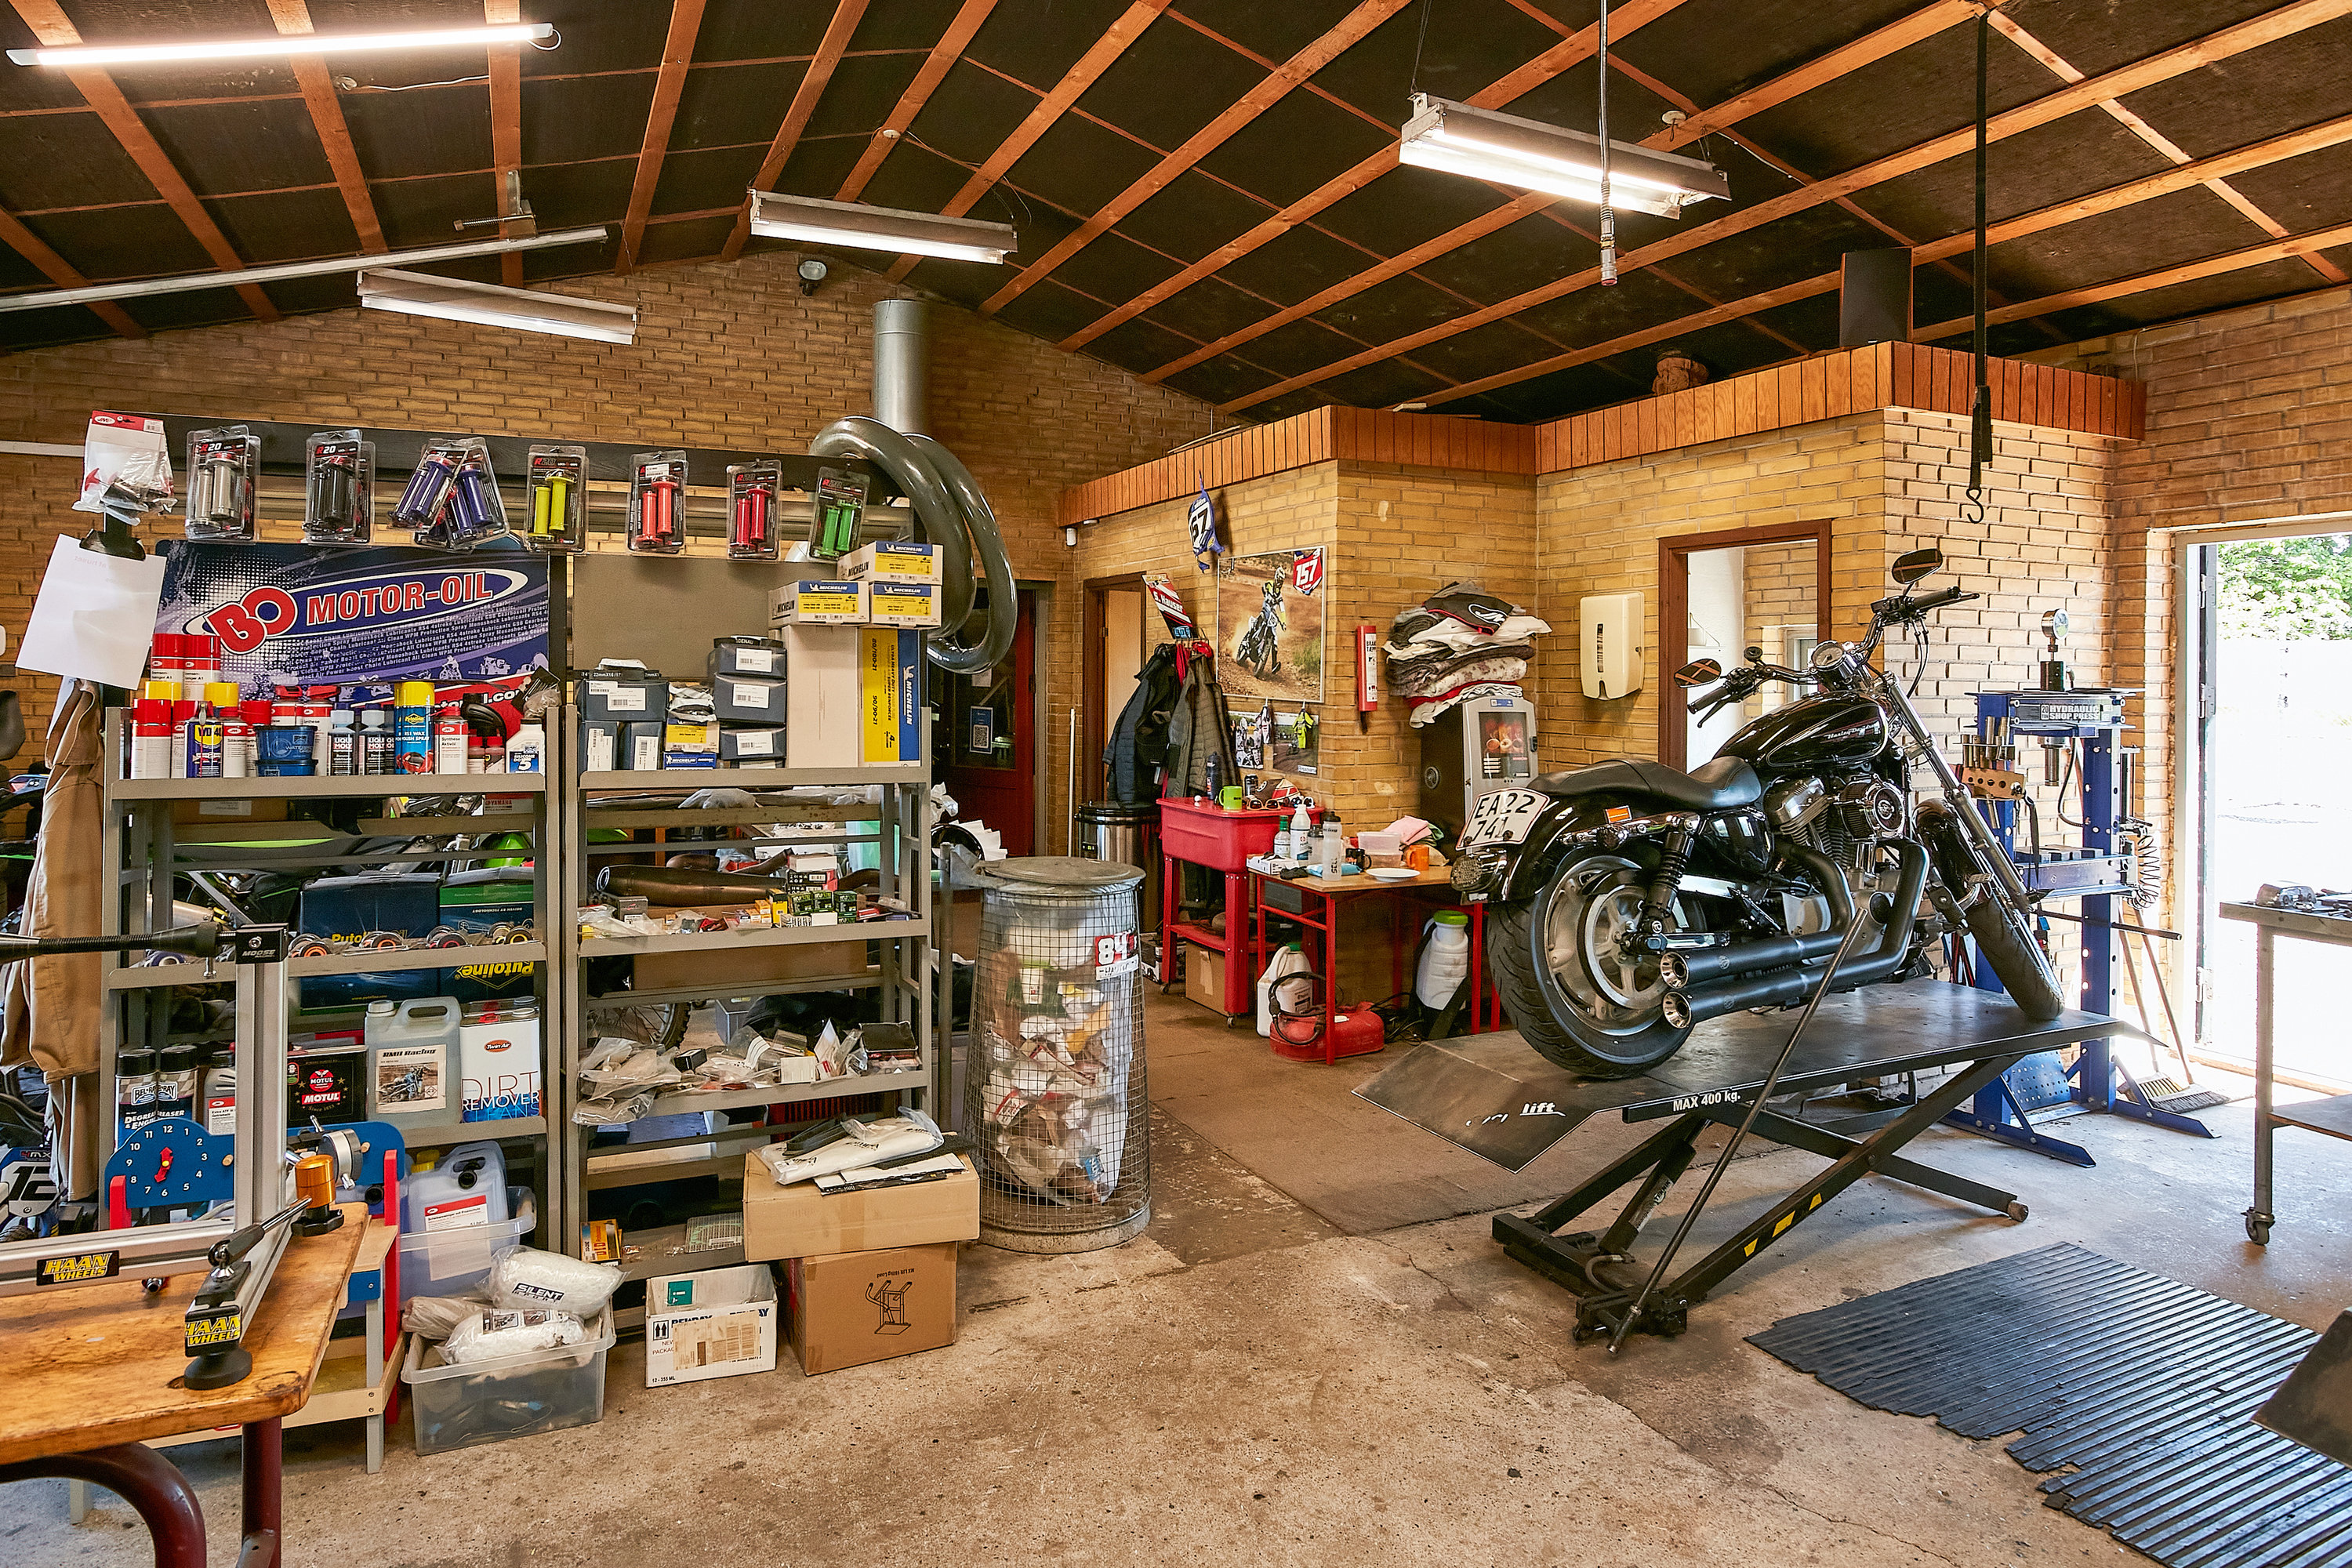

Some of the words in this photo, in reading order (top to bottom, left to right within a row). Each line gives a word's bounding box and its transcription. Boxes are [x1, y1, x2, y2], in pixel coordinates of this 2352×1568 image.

[201, 442, 223, 452] R20
[316, 445, 336, 455] R20
[534, 457, 556, 466] R20
[848, 561, 869, 577] MICHELIN
[1295, 558, 1319, 586] 157
[777, 600, 795, 613] MICHELIN
[1152, 591, 1161, 603] S.
[1160, 594, 1183, 613] Hauser
[206, 586, 296, 654] BO
[307, 572, 494, 625] MOTOR-OIL
[518, 758, 532, 771] 5
[1472, 816, 1509, 841] 741
[404, 1048, 437, 1057] Racing
[462, 1070, 539, 1104] DIRT
[303, 1093, 339, 1103] MOTUL
[463, 1091, 539, 1112] REMOVER
[1672, 1098, 1699, 1112] MAX
[1701, 1093, 1722, 1107] 400
[1724, 1091, 1741, 1103] kg.
[462, 1102, 539, 1123] CLEANS
[1523, 1102, 1555, 1113] lift
[163, 1125, 173, 1134] 12
[144, 1185, 151, 1194] 7
[43, 1253, 113, 1275] HAAN
[54, 1266, 106, 1281] WHEELS
[517, 1284, 564, 1301] SILENT
[185, 1316, 240, 1336] HAAN
[188, 1330, 241, 1346] WHEELS
